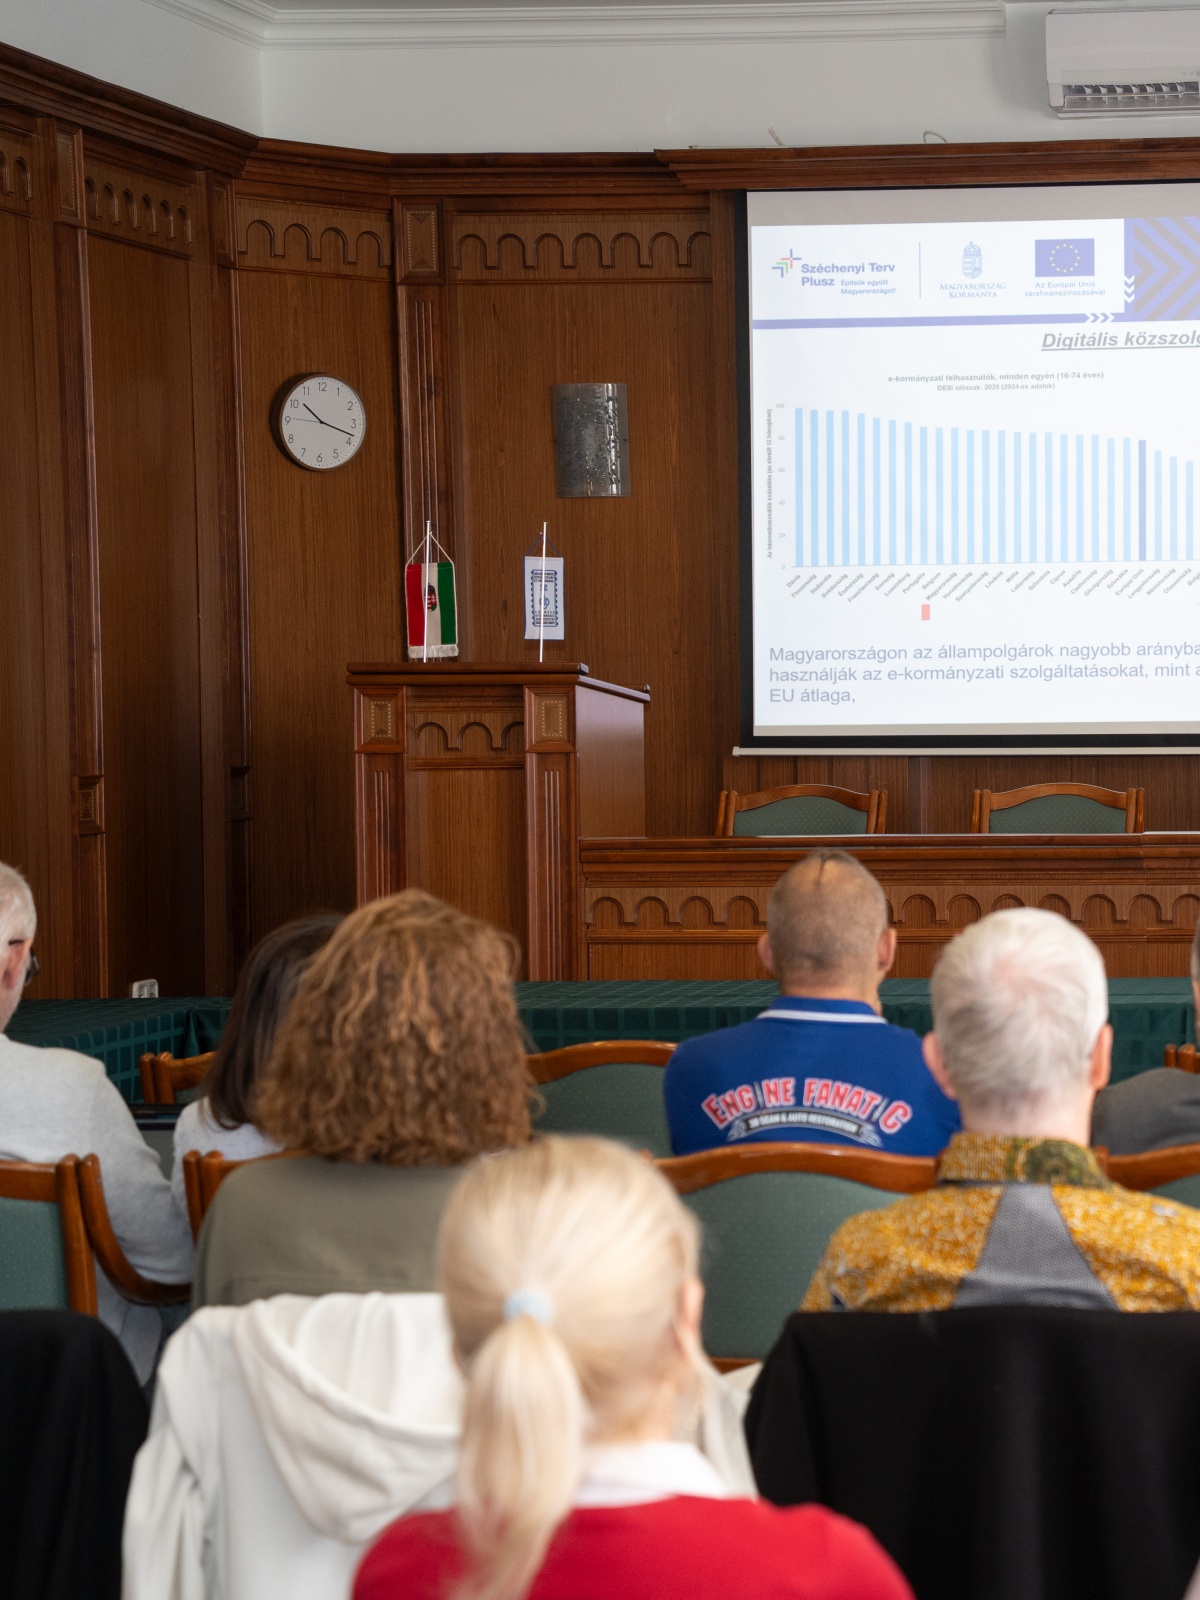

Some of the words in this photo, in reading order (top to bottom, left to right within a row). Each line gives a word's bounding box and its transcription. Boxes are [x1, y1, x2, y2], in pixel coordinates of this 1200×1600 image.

[801, 263, 865, 274] Széchenyi
[869, 263, 895, 272] Terv
[802, 277, 835, 286] Plusz
[841, 279, 865, 287] Építsük
[940, 282, 1006, 290] MAGYARORSZÁG
[1048, 281, 1076, 289] Európai
[949, 290, 997, 299] KORMÁNYA
[1025, 289, 1105, 297] társfinanszírozásával
[1042, 332, 1119, 349] Digitális
[888, 374, 944, 384] e-kormányzati
[1030, 373, 1055, 382] egyén
[1057, 372, 1080, 380] (16-74
[1083, 372, 1104, 380] éves)
[303, 386, 310, 396] 11
[318, 382, 328, 392] 12
[290, 399, 299, 408] 10
[347, 401, 354, 411] 2
[284, 416, 291, 426] 9
[351, 419, 357, 429] 3
[288, 434, 294, 444] 8
[346, 437, 352, 446] 4
[301, 448, 306, 457] 7
[317, 453, 323, 462] 6
[333, 449, 339, 459] 5
[921, 572, 942, 591] Belgium
[770, 646, 908, 664] Magyarországon
[914, 648, 932, 659] az
[938, 645, 1054, 662] állampolgárok
[1060, 643, 1131, 660] nagyobb
[770, 667, 857, 684] használják
[862, 670, 882, 680] az
[888, 666, 1004, 682] e-kormányzati
[1010, 664, 1148, 681] szolgáltatásokat,
[1155, 663, 1190, 677] mint
[770, 689, 794, 702] EU
[801, 688, 856, 705] átlaga,
[701, 1077, 796, 1130] ENGINE
[803, 1077, 913, 1134] FANATIC
